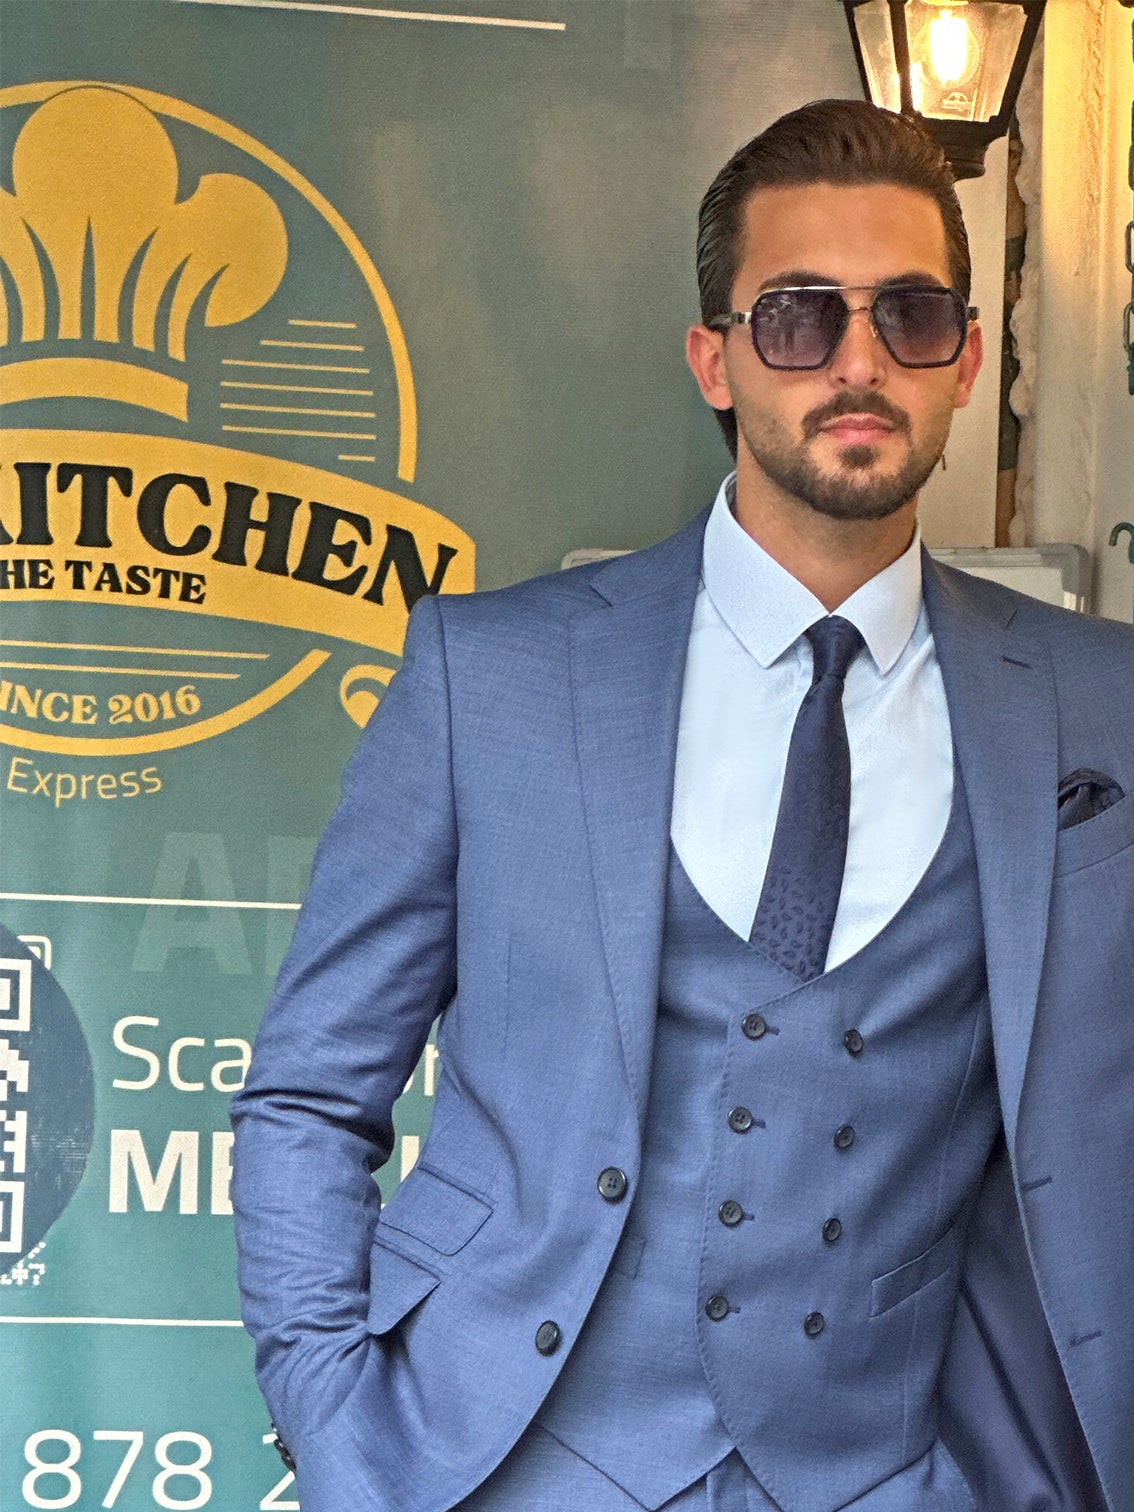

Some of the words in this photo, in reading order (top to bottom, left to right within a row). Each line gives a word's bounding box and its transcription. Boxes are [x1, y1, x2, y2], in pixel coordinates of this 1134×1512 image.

[0, 461, 458, 615] ITCHEN
[0, 558, 55, 590] HE
[64, 560, 207, 605] TASTE
[0, 680, 98, 724] INCE
[108, 685, 202, 725] 2016
[6, 757, 163, 808] Express
[112, 1015, 252, 1092] Sca
[21, 1429, 213, 1511] 878
